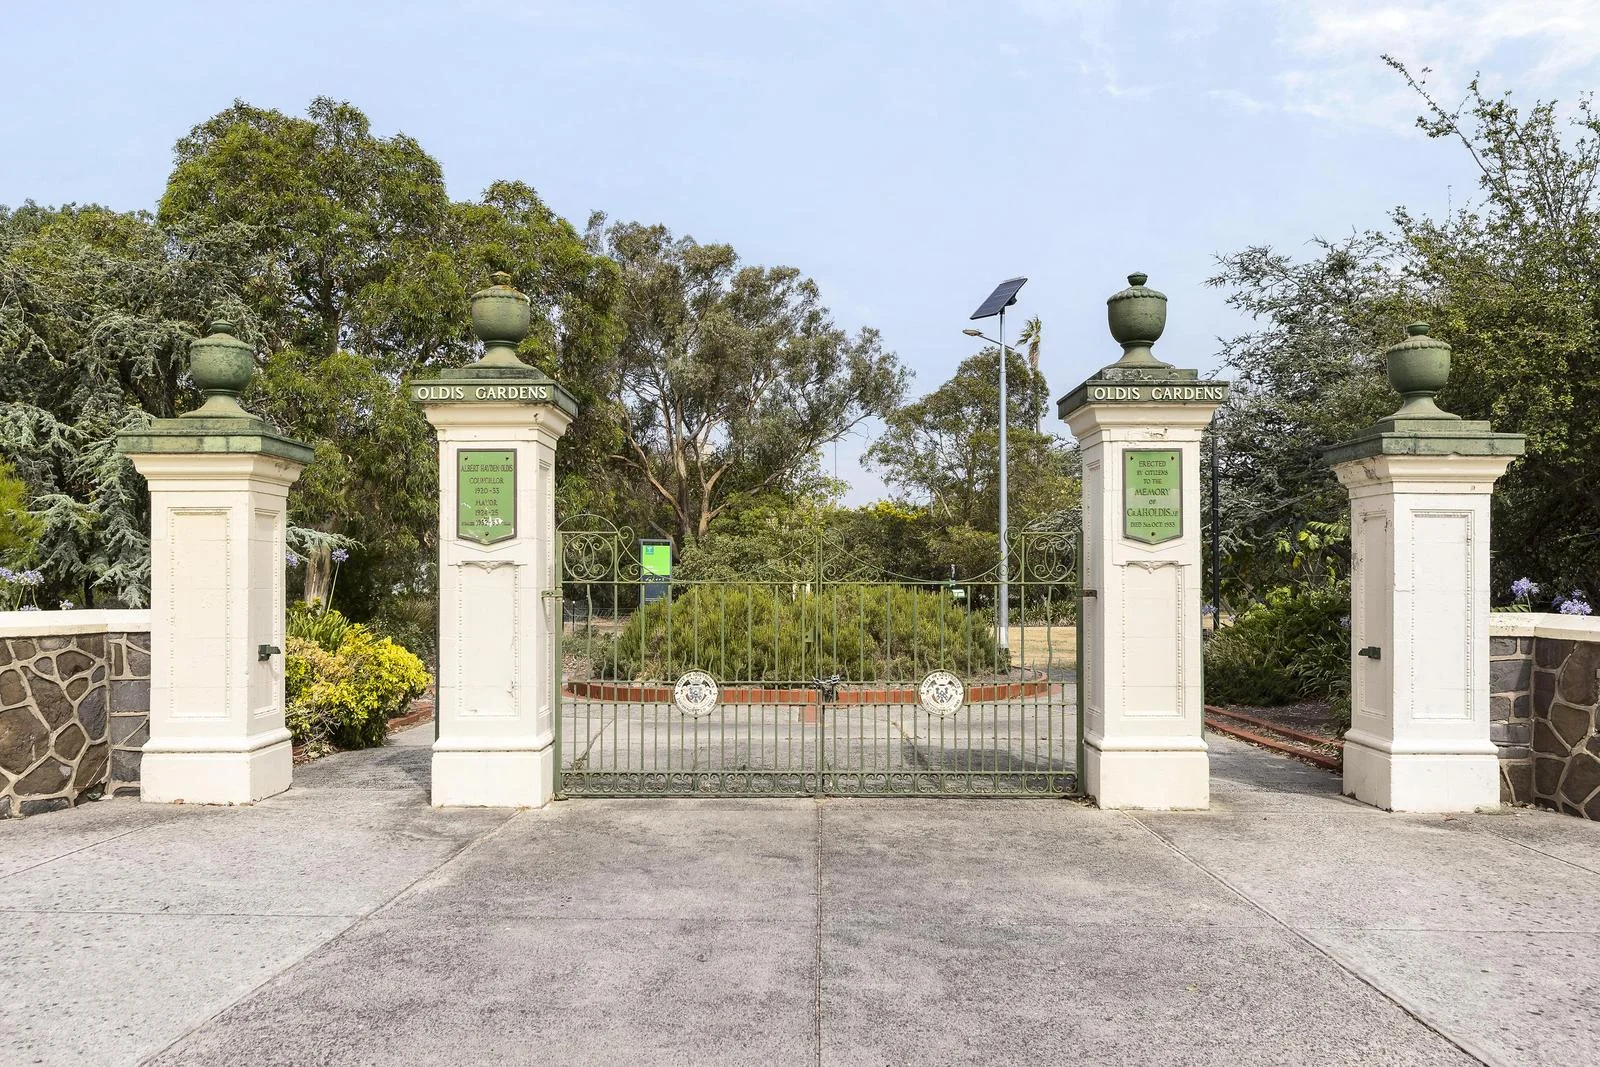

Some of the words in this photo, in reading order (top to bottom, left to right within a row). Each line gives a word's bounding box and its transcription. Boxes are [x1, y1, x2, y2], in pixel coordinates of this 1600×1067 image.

[417, 386, 465, 400] OLDIS
[475, 386, 548, 400] GARDENS
[1094, 387, 1141, 400] OLDIS
[1151, 386, 1224, 400] GARDENS
[1138, 460, 1167, 468] ERECTED
[461, 464, 480, 473] ALBERT
[469, 477, 505, 485] COUNCILLOR
[1134, 488, 1171, 496] MEMORY
[475, 499, 498, 507] MAYOR
